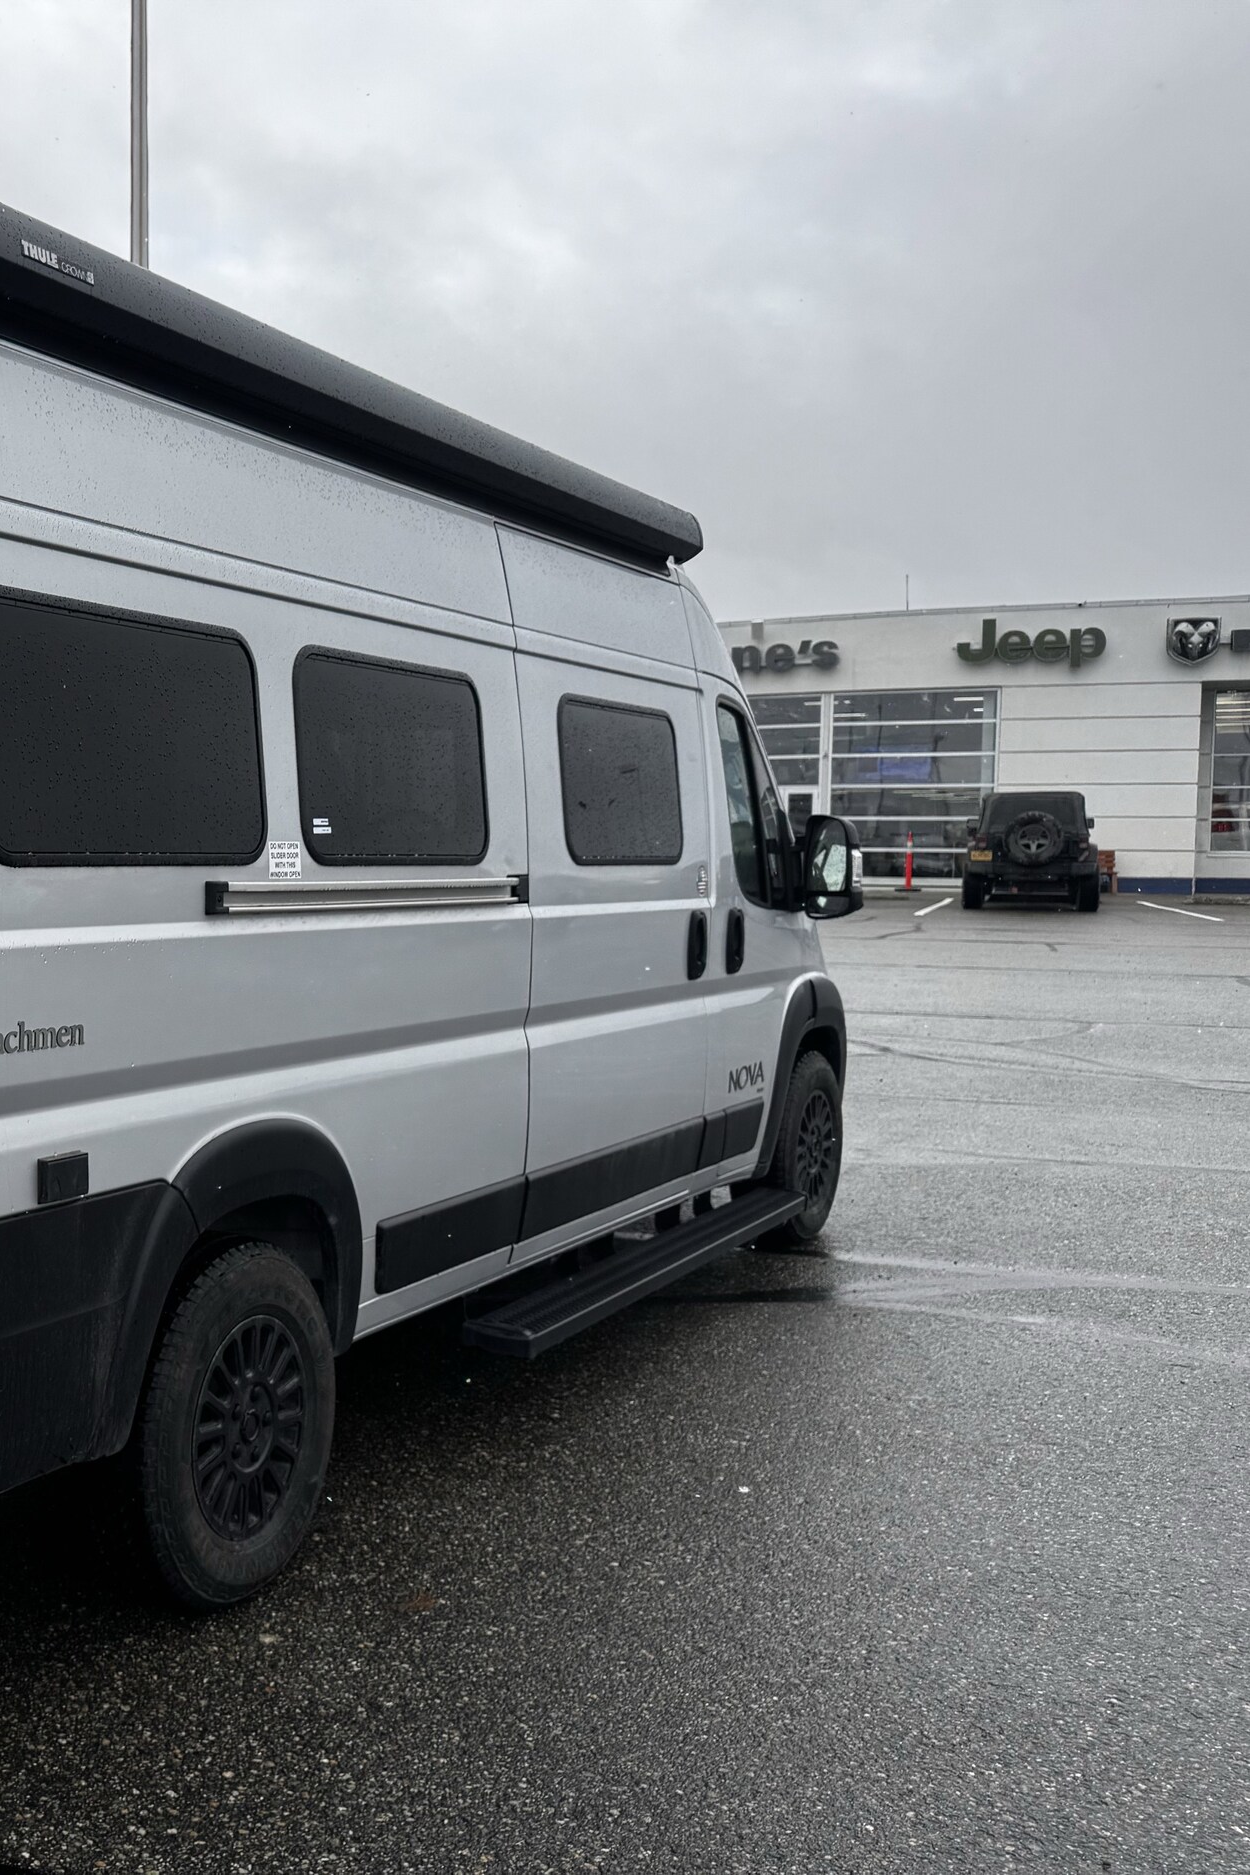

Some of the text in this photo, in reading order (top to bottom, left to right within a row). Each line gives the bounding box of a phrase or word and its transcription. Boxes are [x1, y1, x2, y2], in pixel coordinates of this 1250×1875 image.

[21, 239, 59, 270] THULE
[956, 618, 1107, 668] Jeep
[270, 842, 299, 850] DO NOT OPEN
[270, 851, 299, 860] SLIDER DOOR
[275, 861, 296, 869] WITH THIS
[728, 1060, 765, 1094] NOVA
